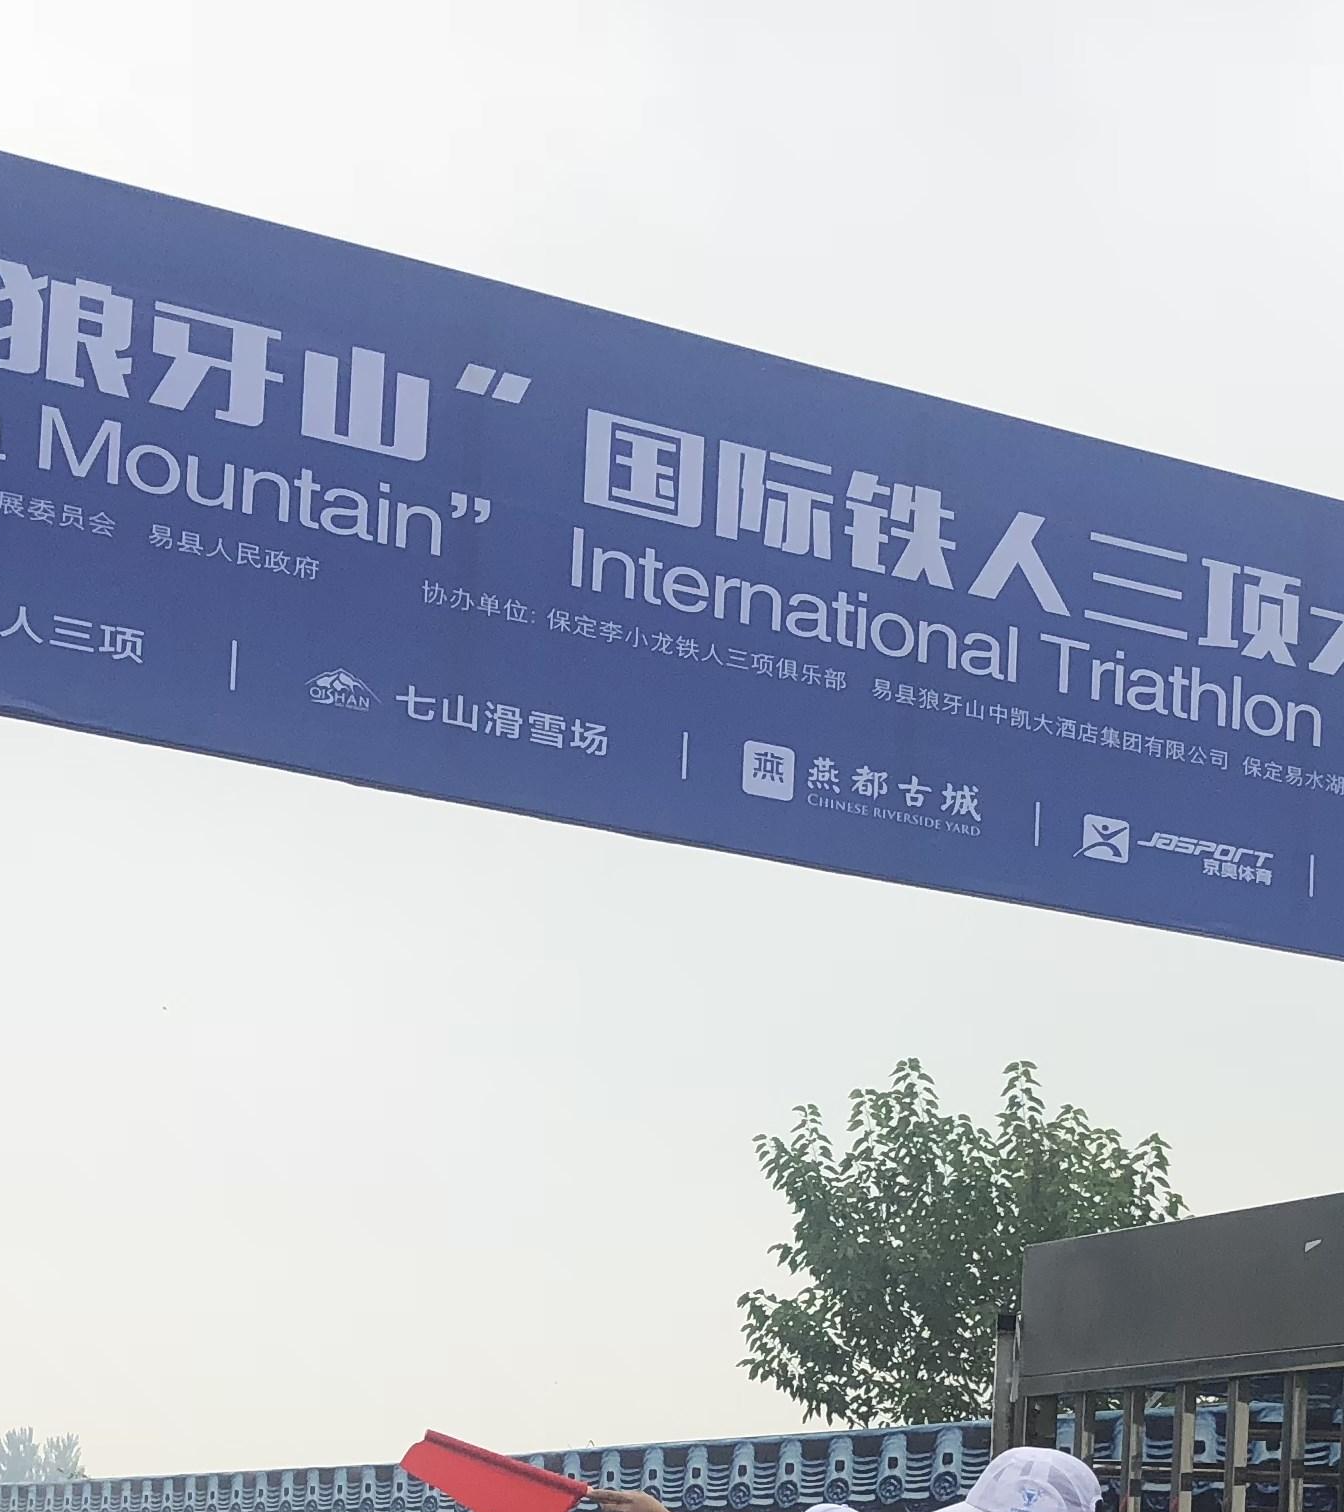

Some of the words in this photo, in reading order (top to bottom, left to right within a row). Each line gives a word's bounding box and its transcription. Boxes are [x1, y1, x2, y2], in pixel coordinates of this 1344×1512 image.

[148, 524, 320, 581] 易县人民政府
[571, 527, 1017, 683] International
[1040, 633, 1322, 747] Triathlon
[309, 687, 369, 707] QISHAN
[546, 608, 847, 691] 保定李小龙铁人三项俱乐部
[871, 678, 1229, 770] 易县狼牙山中凯大酒店集团有限公司
[396, 685, 608, 756] 七山滑雪场
[807, 757, 982, 822] 燕都古城
[808, 793, 869, 816] CHINESE
[873, 807, 942, 830] RIVERSIDE
[944, 821, 981, 837] YARD
[1202, 858, 1273, 886] 京奥体育
